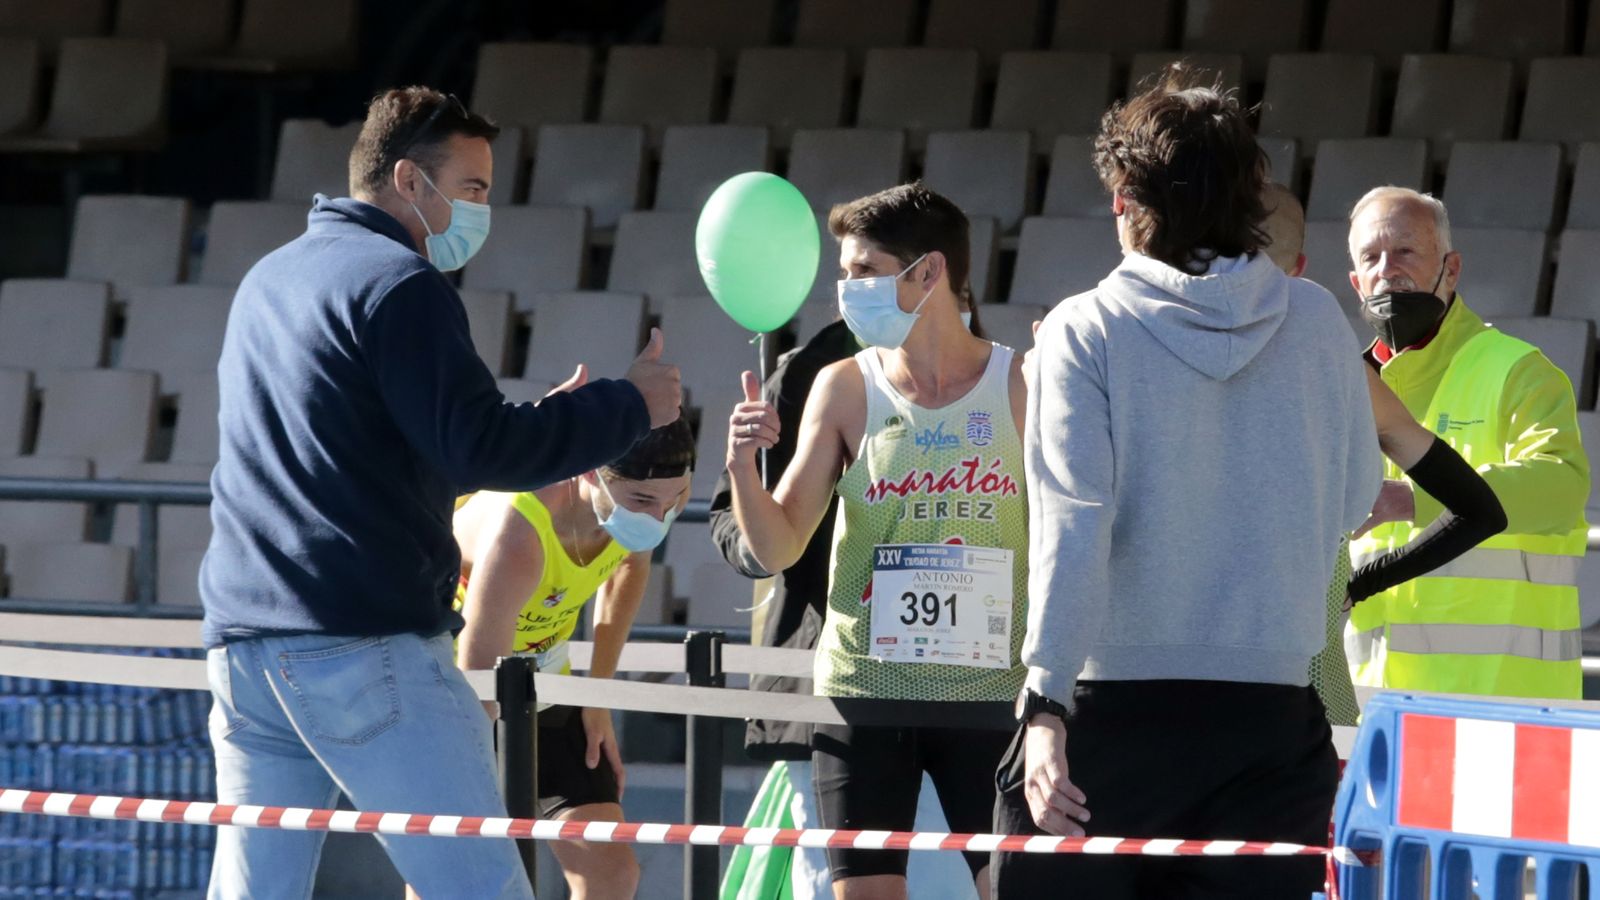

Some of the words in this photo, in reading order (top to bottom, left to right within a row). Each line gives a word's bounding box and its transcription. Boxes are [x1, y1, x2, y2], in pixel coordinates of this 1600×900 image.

[865, 456, 1018, 502] maratón
[899, 501, 995, 520] JEREZ
[877, 549, 902, 566] XXV
[930, 557, 941, 567] DE
[912, 571, 974, 585] ANTONIO
[943, 584, 974, 593] ROMERO
[900, 591, 957, 626] 391
